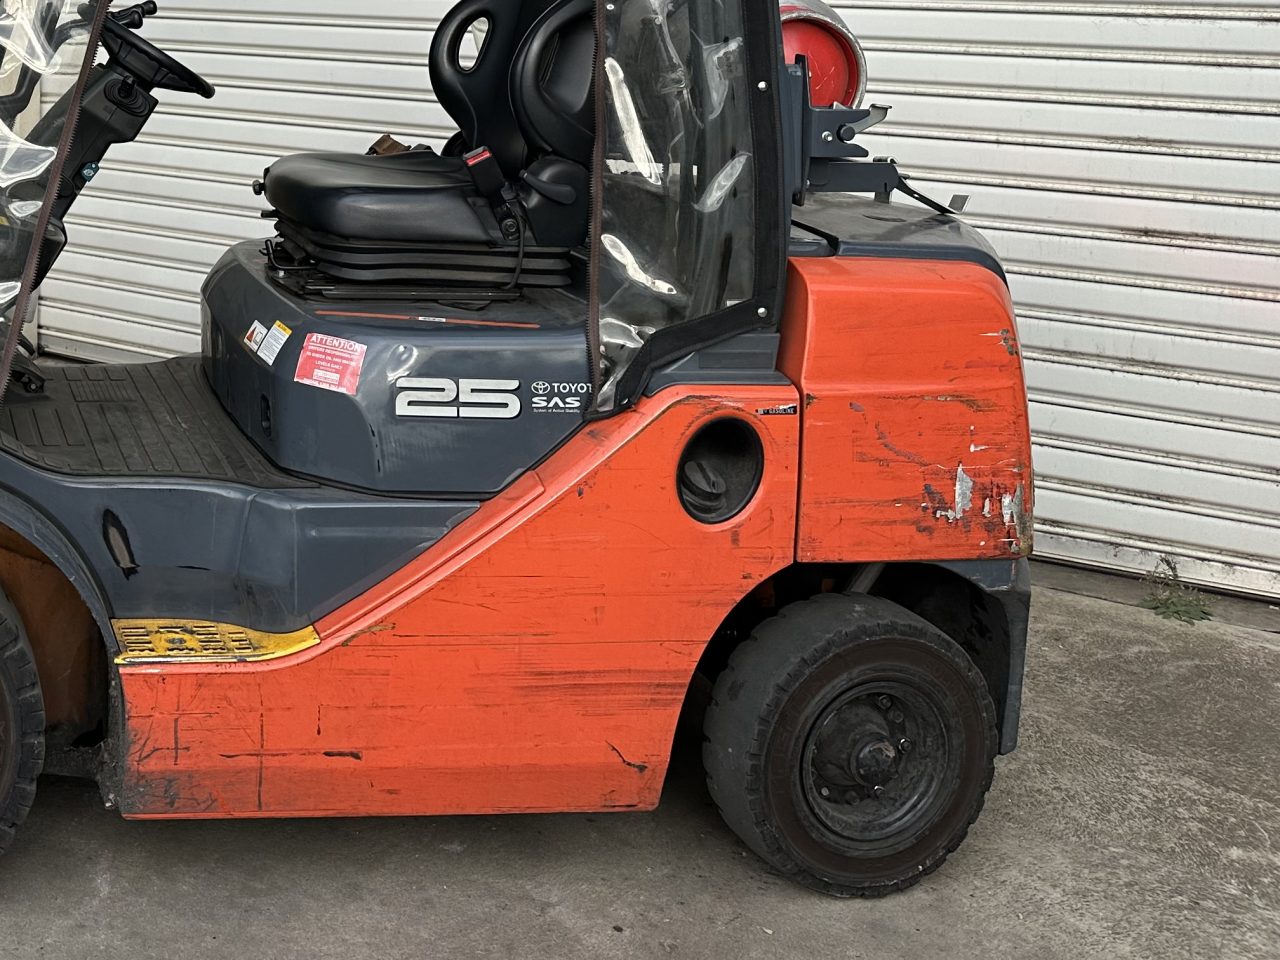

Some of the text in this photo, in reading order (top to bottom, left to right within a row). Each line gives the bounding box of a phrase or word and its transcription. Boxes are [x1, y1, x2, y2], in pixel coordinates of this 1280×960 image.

[310, 334, 360, 352] ATTENTION
[552, 383, 592, 393] TOYOT
[395, 377, 521, 419] 25
[531, 396, 581, 408] SAS
